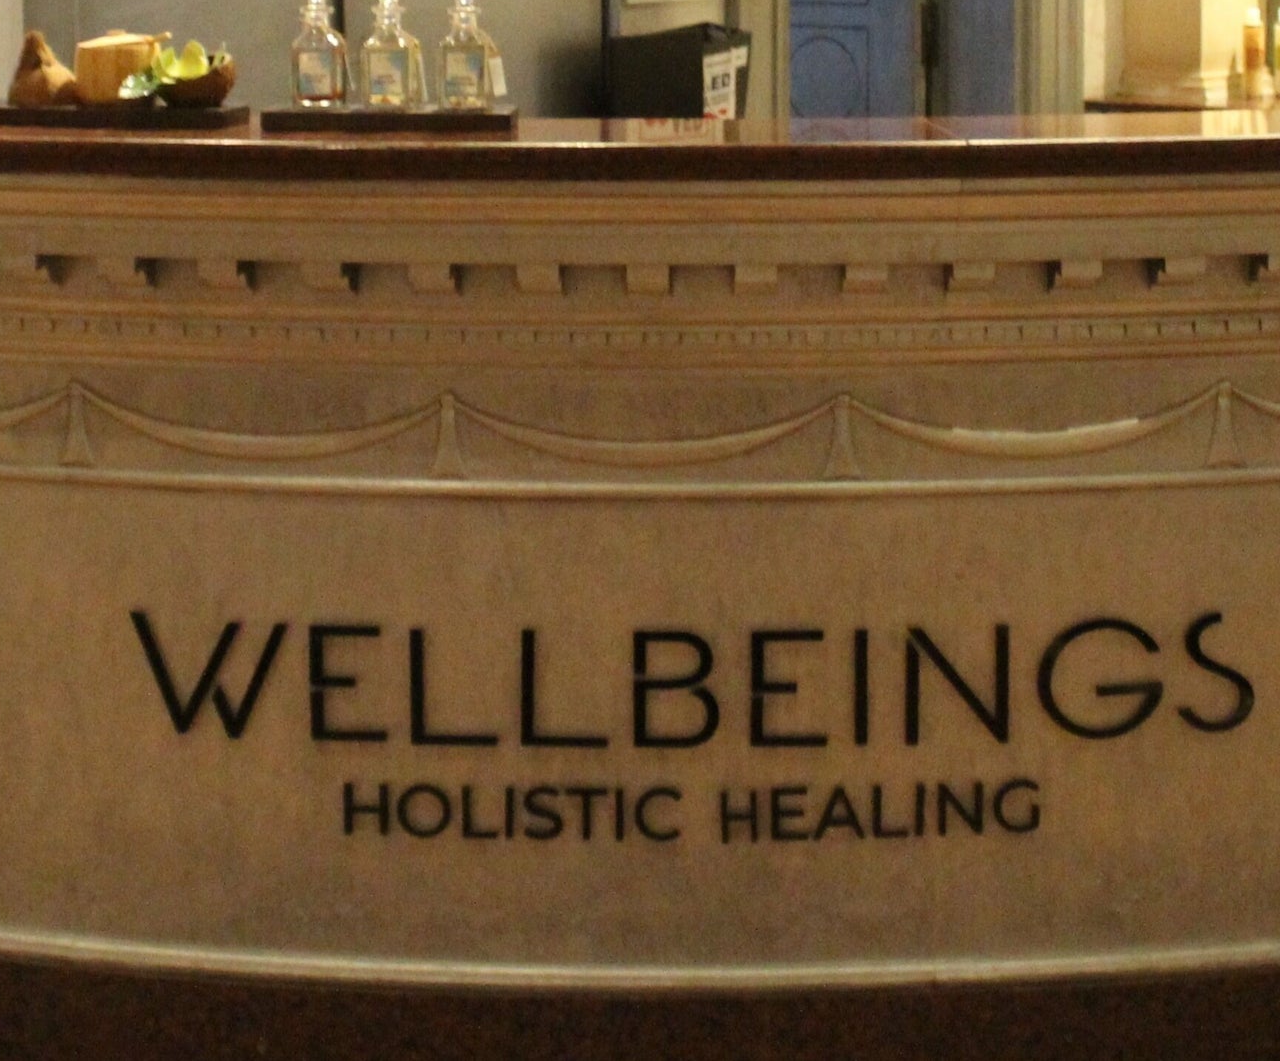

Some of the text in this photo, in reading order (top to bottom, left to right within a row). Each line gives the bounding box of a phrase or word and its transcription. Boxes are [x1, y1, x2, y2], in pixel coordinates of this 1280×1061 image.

[131, 611, 1254, 748] WELLBEINGS
[341, 778, 1041, 845] HOLISTIC HEALING
